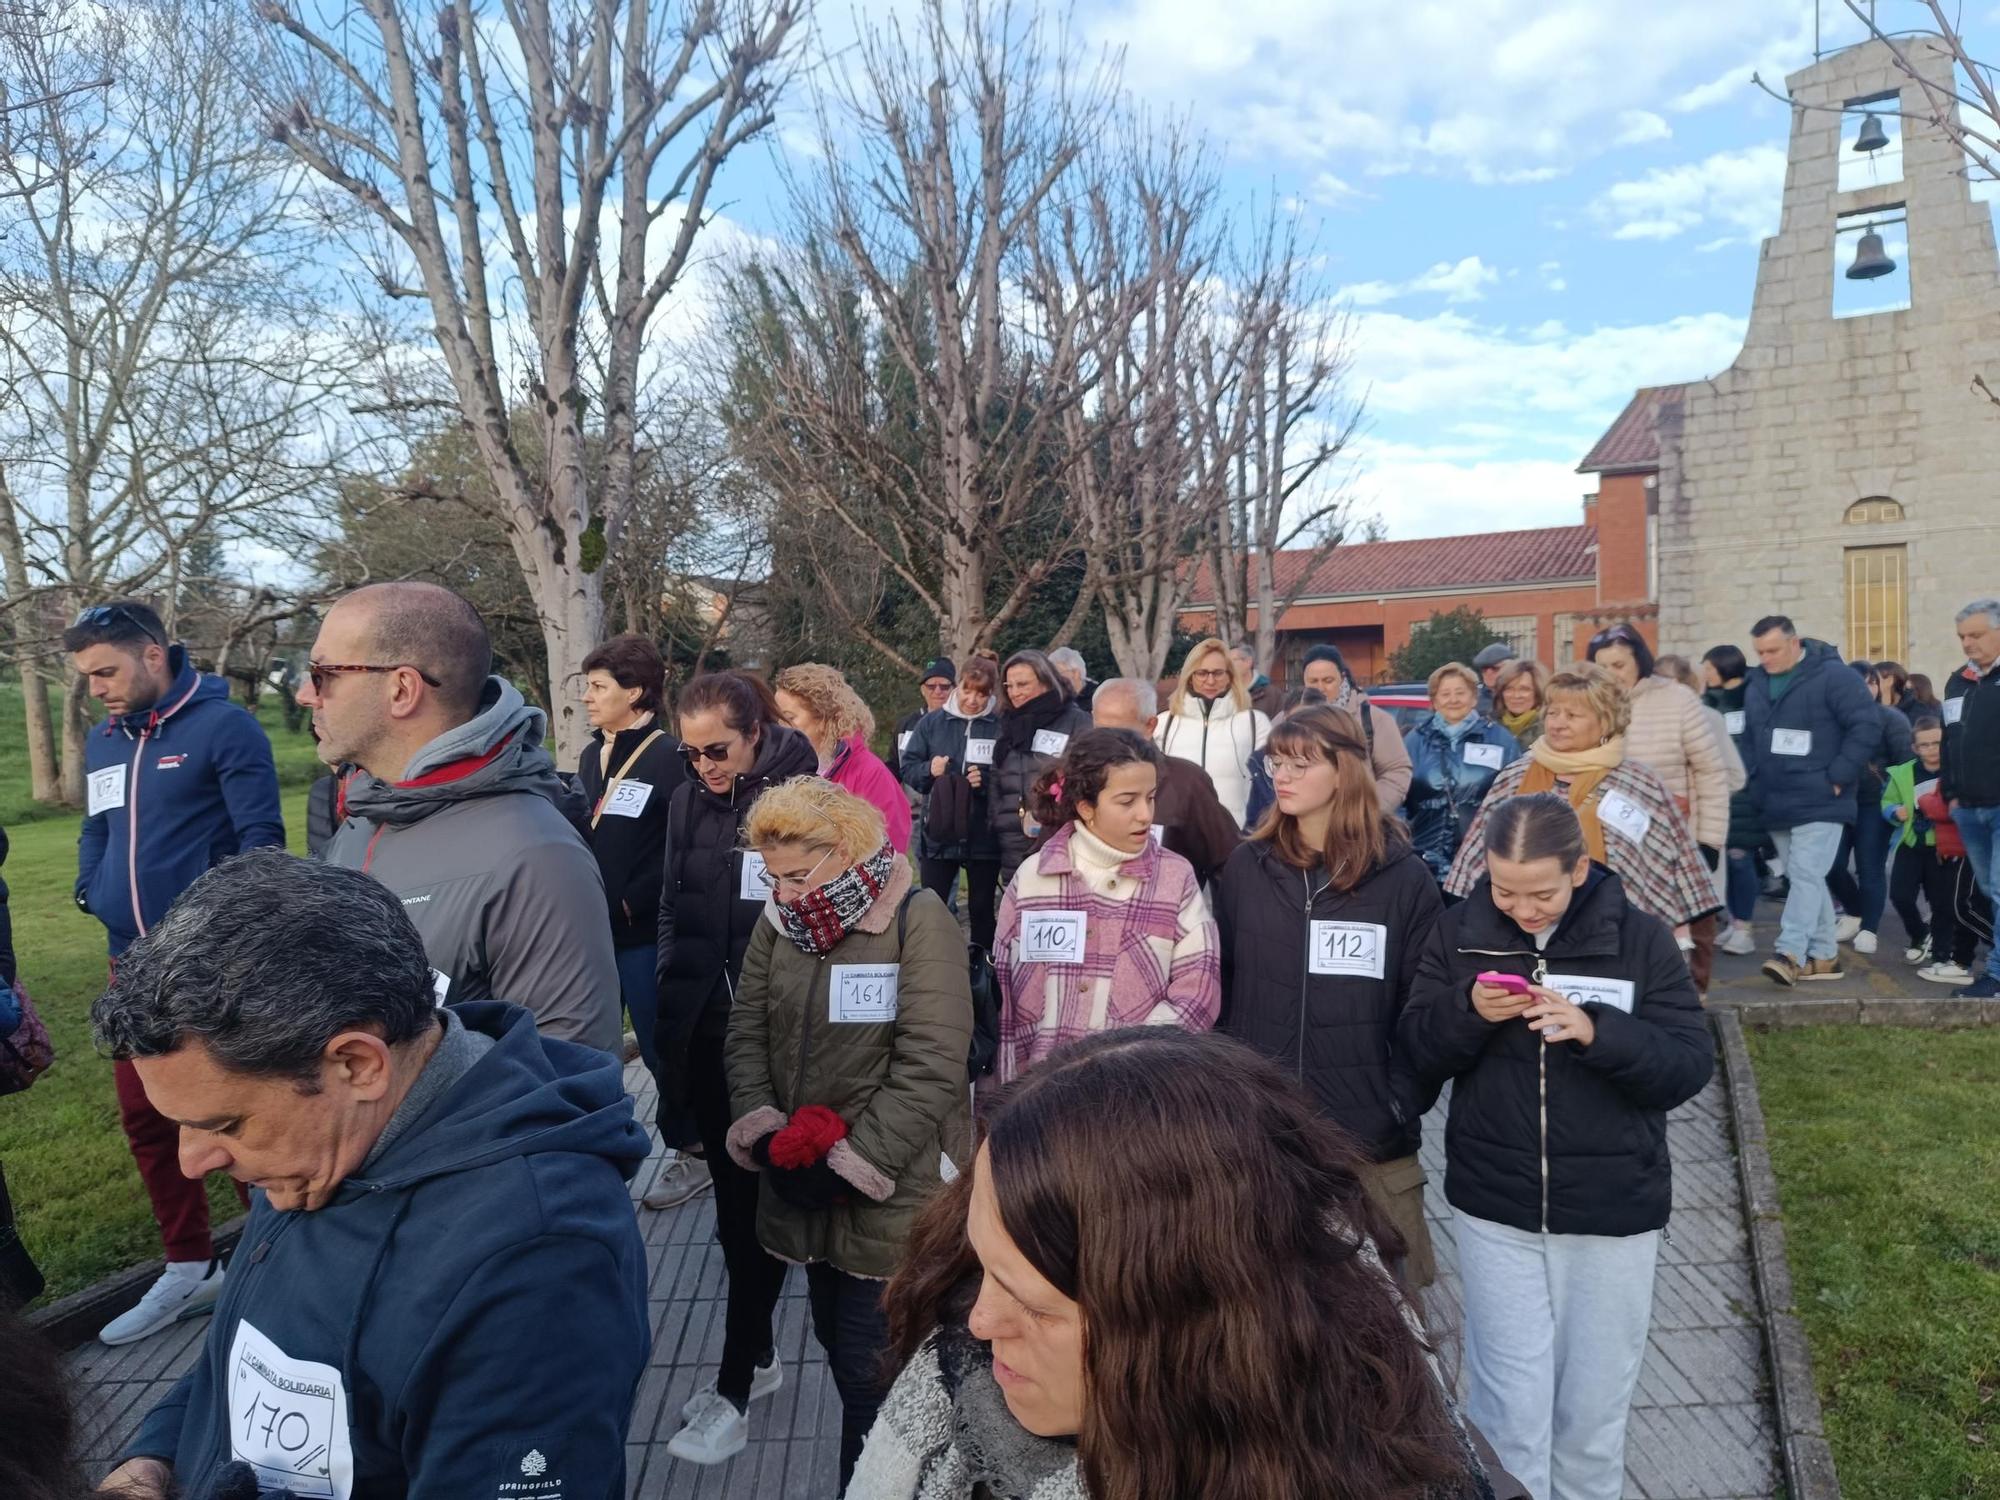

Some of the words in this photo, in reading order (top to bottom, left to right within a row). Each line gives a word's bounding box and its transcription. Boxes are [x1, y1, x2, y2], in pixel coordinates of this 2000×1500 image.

[616, 787, 637, 802] 55
[400, 894, 432, 906] ONTANE
[1033, 925, 1066, 949] 110
[1325, 932, 1363, 958] 112
[850, 983, 883, 1004] 161
[251, 1356, 278, 1386] CAMINATA
[278, 1377, 331, 1397] SOLIDARIA
[244, 1391, 310, 1452] 170
[498, 1479, 562, 1491] SPRINGFIELD
